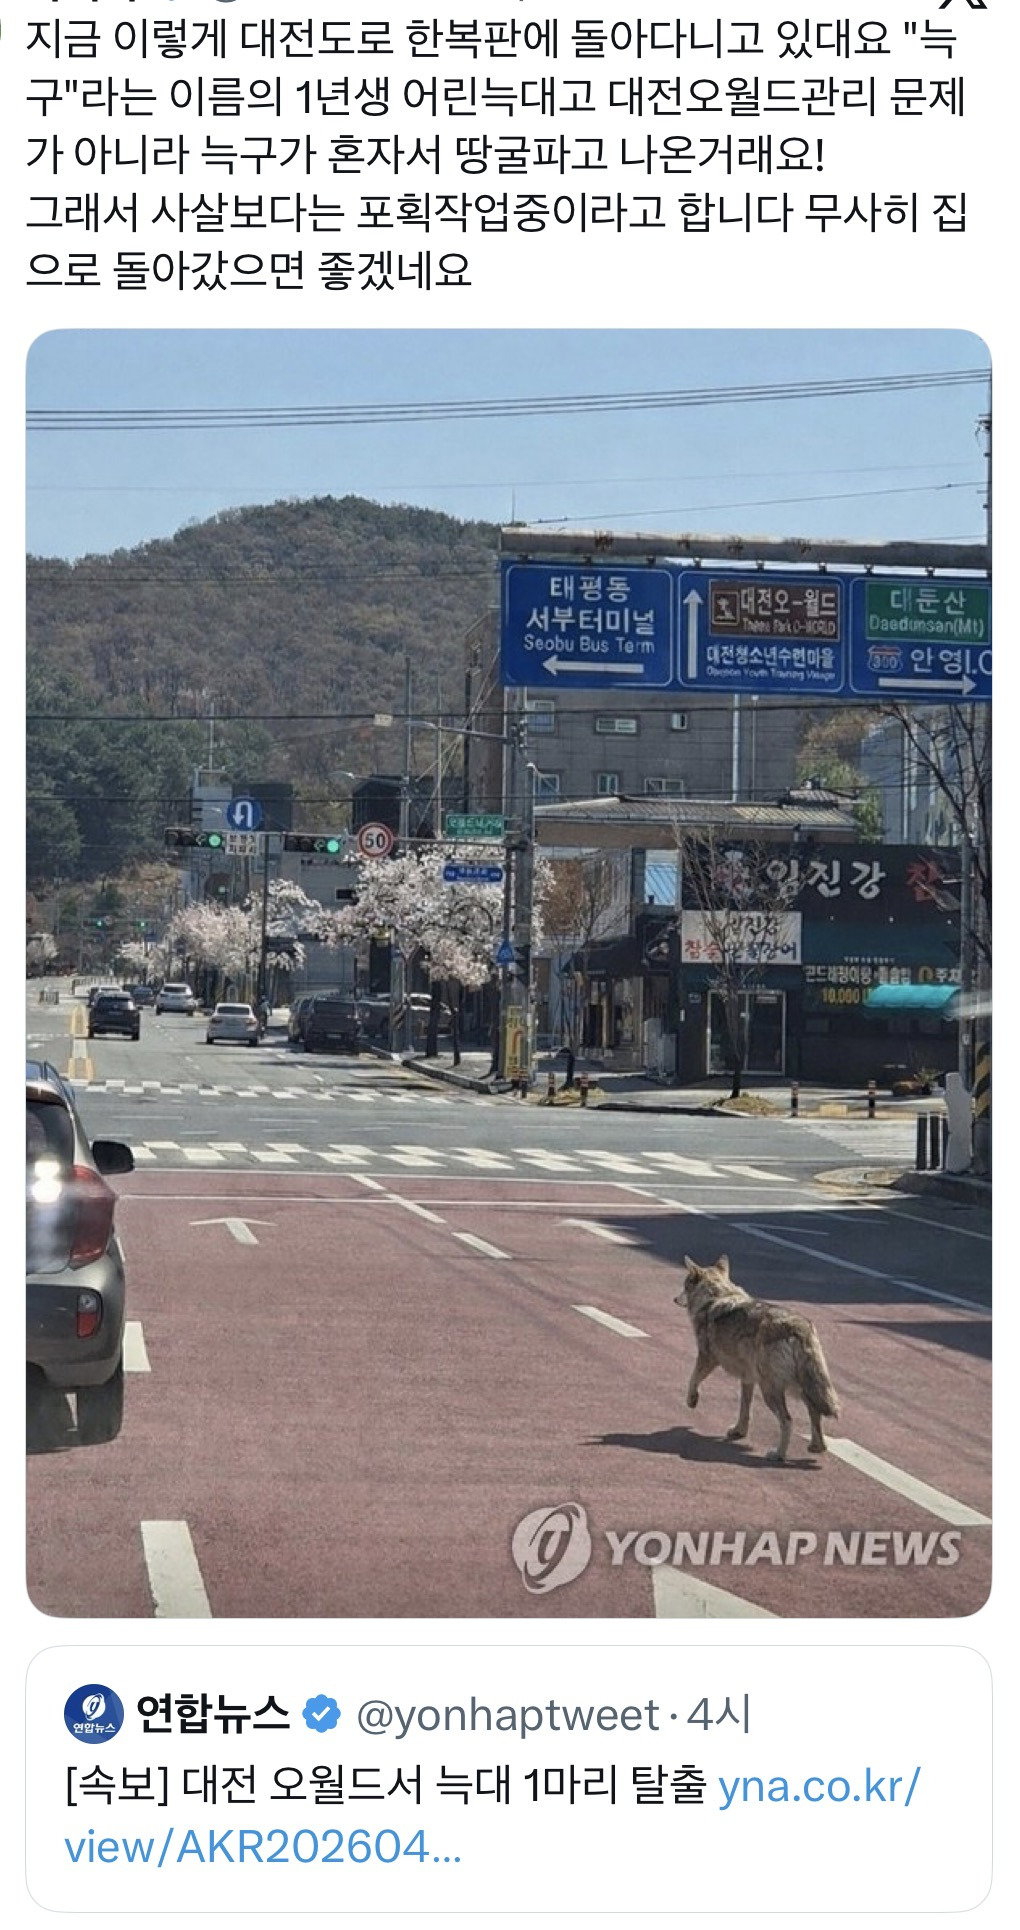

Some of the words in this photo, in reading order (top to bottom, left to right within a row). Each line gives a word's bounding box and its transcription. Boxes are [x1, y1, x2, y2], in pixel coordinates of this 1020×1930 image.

[550, 575, 630, 603] 태평동
[890, 587, 967, 615] 대둔산
[526, 606, 655, 635] 서부터미널
[869, 614, 984, 638] Daedunsan(Mt)
[524, 633, 574, 651] Seobu
[579, 635, 609, 653] Bus
[616, 637, 655, 654] Term
[706, 645, 835, 669] 대전청소년수련마을
[365, 833, 386, 849] 50
[766, 859, 887, 900] 임진강
